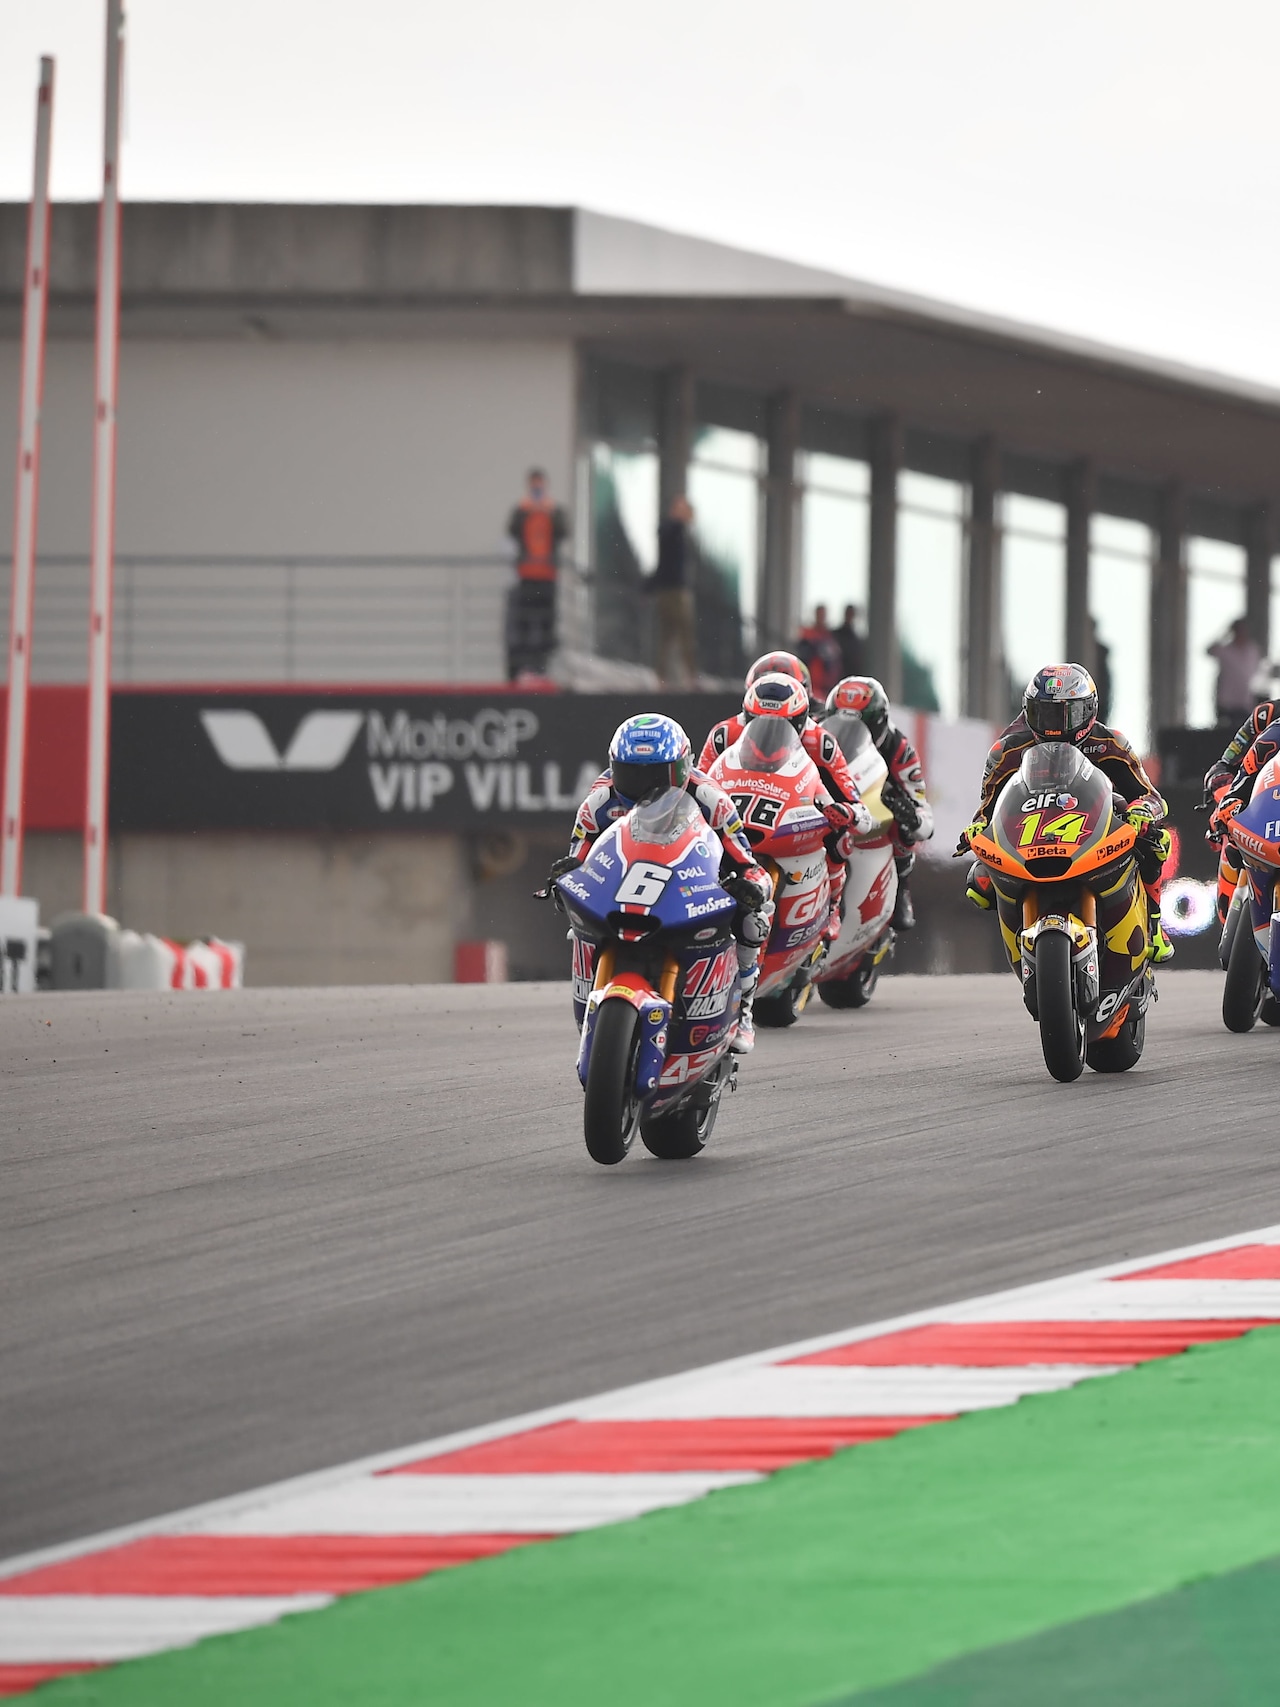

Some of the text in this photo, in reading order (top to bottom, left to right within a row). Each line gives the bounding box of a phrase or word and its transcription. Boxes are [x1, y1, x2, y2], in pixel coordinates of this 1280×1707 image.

[367, 708, 539, 760] MotoGP
[367, 761, 453, 812] VIP
[735, 778, 783, 796] AutoSolar
[1022, 793, 1057, 812] elf
[1017, 812, 1090, 848] 14
[1038, 847, 1067, 856] Beta
[1106, 838, 1130, 856] Beta
[1232, 828, 1266, 856] STIHL
[595, 851, 614, 870] DELL
[981, 848, 1003, 866] Beta
[677, 866, 706, 880] DELL
[615, 862, 672, 905] 6
